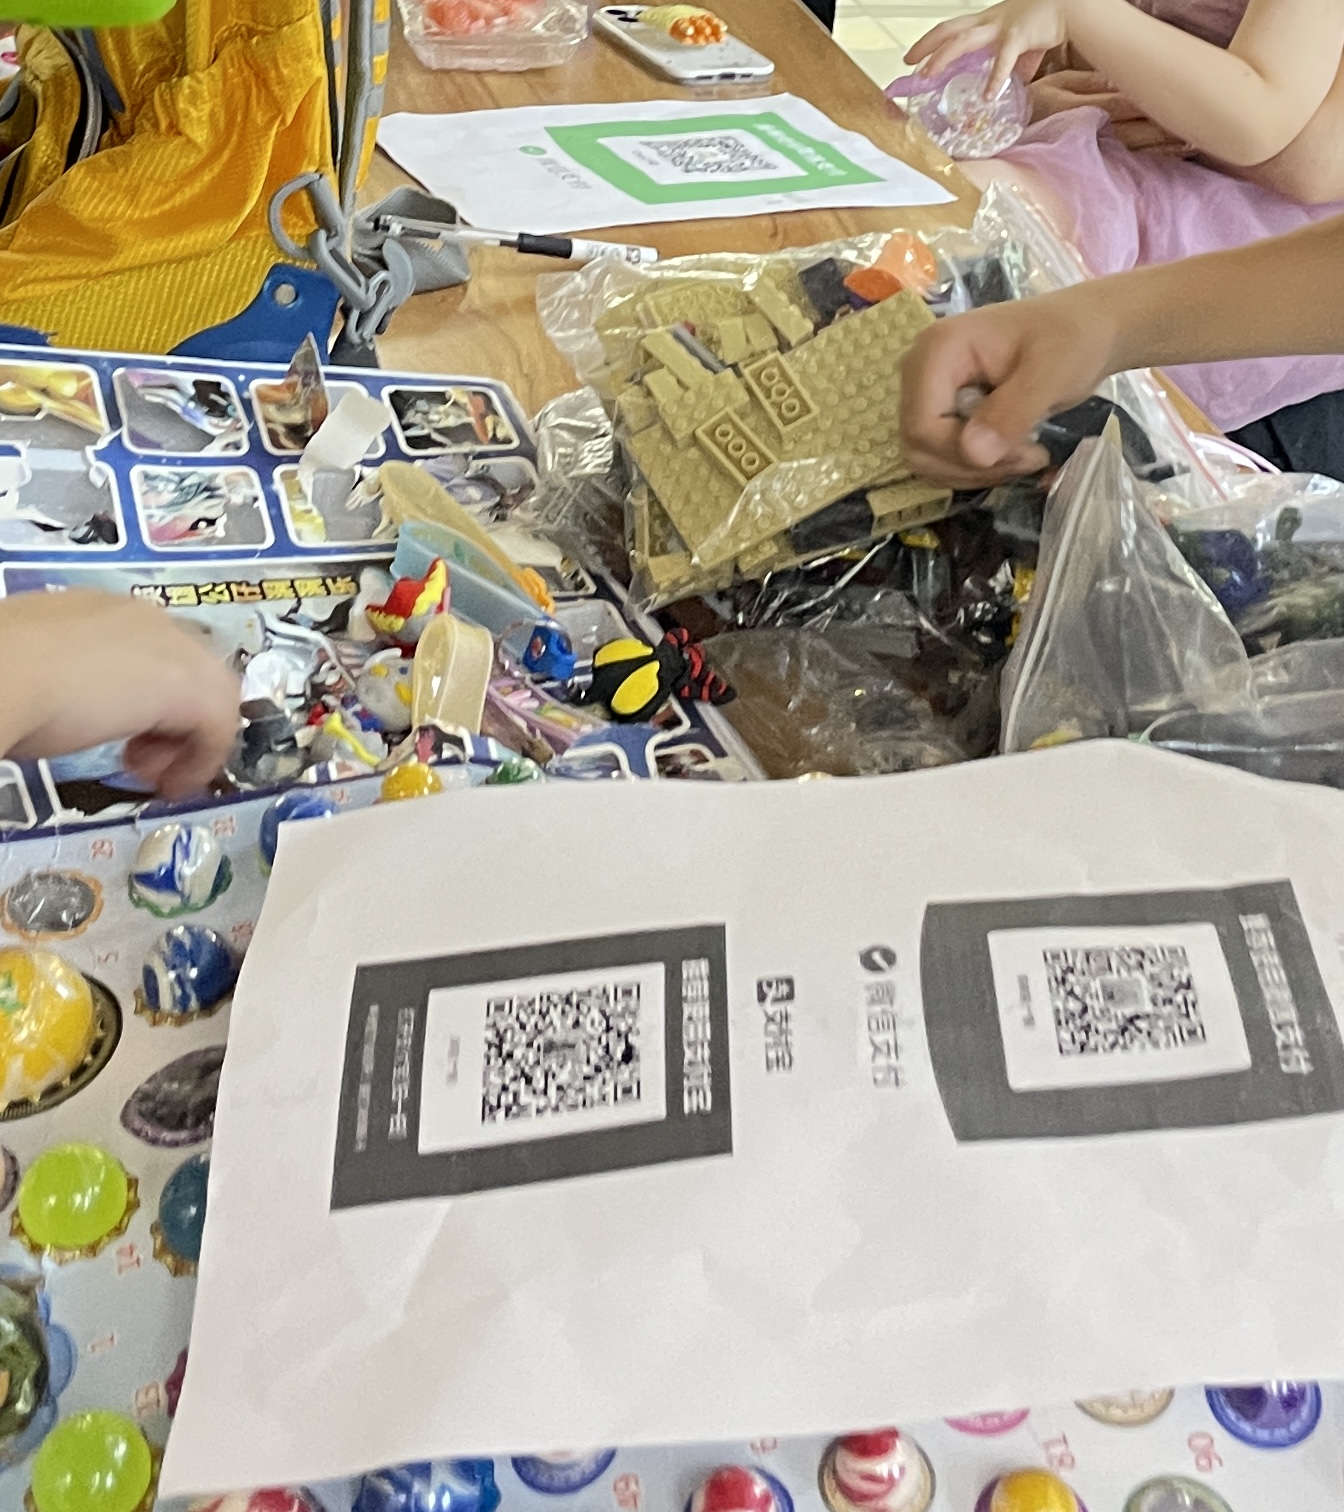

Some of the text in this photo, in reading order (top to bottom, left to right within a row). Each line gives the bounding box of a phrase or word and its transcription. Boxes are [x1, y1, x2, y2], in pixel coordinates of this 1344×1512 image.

[763, 1006, 794, 1074] 支付宝
[861, 980, 909, 1091] 微信支付
[1187, 1432, 1224, 1472] 90
